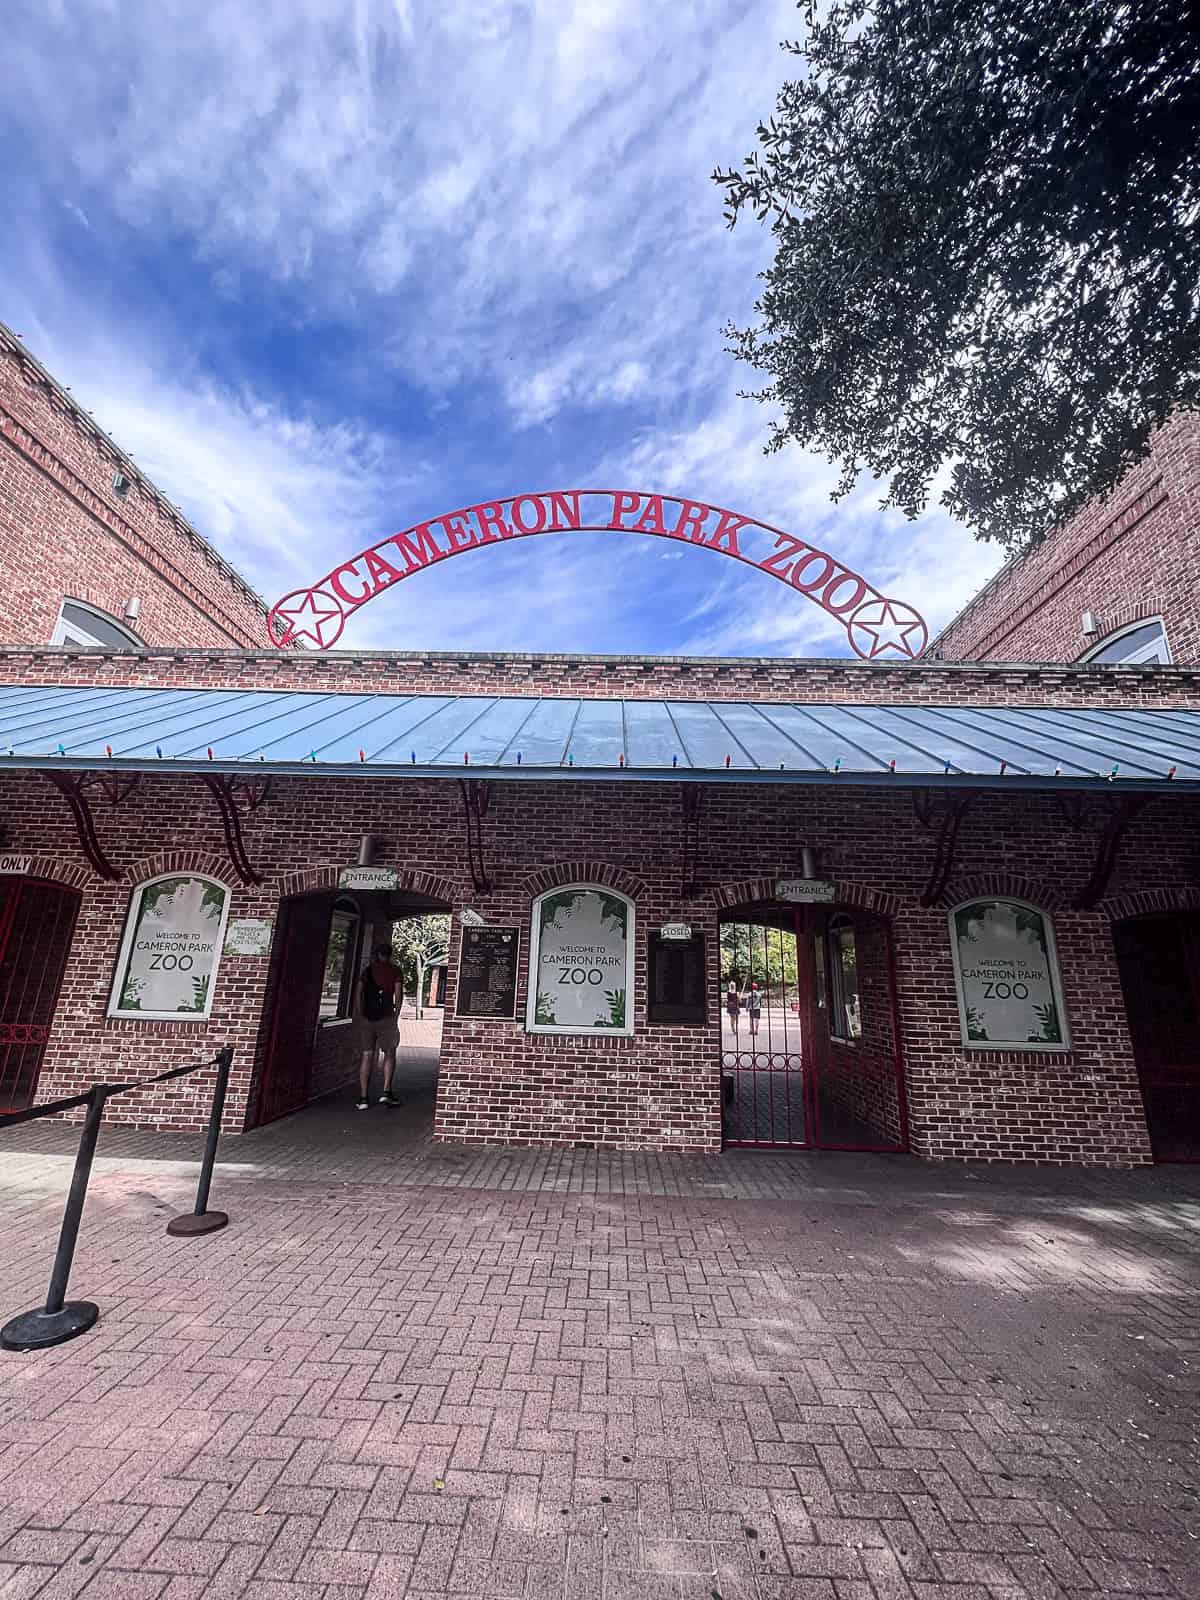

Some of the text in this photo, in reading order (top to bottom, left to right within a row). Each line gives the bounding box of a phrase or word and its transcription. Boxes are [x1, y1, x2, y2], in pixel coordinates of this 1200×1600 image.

[331, 491, 867, 614] CAMERON PARK ZOO
[1, 857, 31, 870] ONLY
[346, 873, 392, 881] ENTRANCE
[781, 886, 830, 896] ENTRANCE
[662, 928, 690, 936] CLOSED
[137, 941, 213, 952] CAMERON PARK
[560, 945, 597, 953] WELCOME
[149, 953, 194, 971] ZOO
[542, 955, 622, 966] CAMERON PARK
[558, 967, 604, 985] ZOO
[961, 969, 1044, 980] CAMERON PARK
[981, 982, 1029, 999] ZOO
